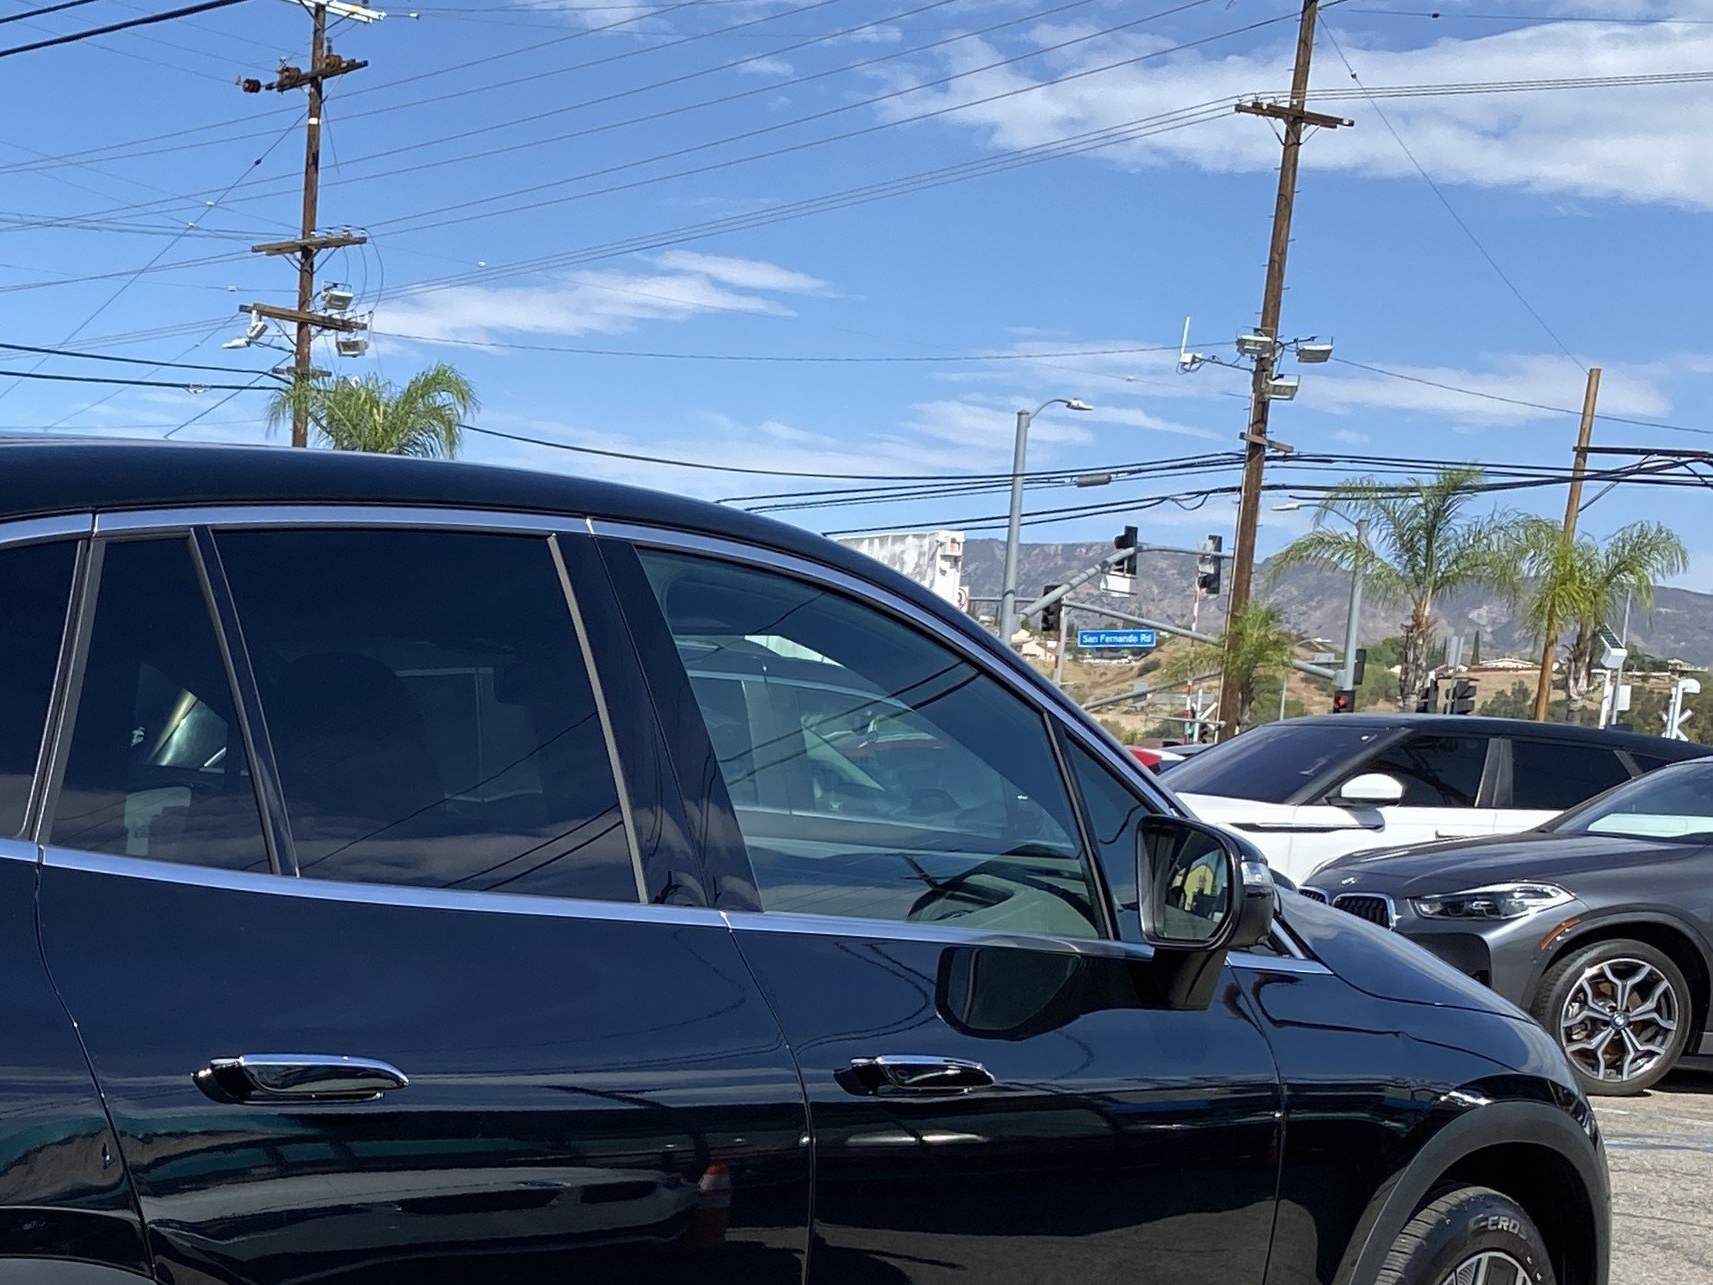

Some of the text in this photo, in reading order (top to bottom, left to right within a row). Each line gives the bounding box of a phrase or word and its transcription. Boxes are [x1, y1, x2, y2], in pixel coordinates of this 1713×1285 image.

[1082, 633, 1152, 644] San Fernando Rd
